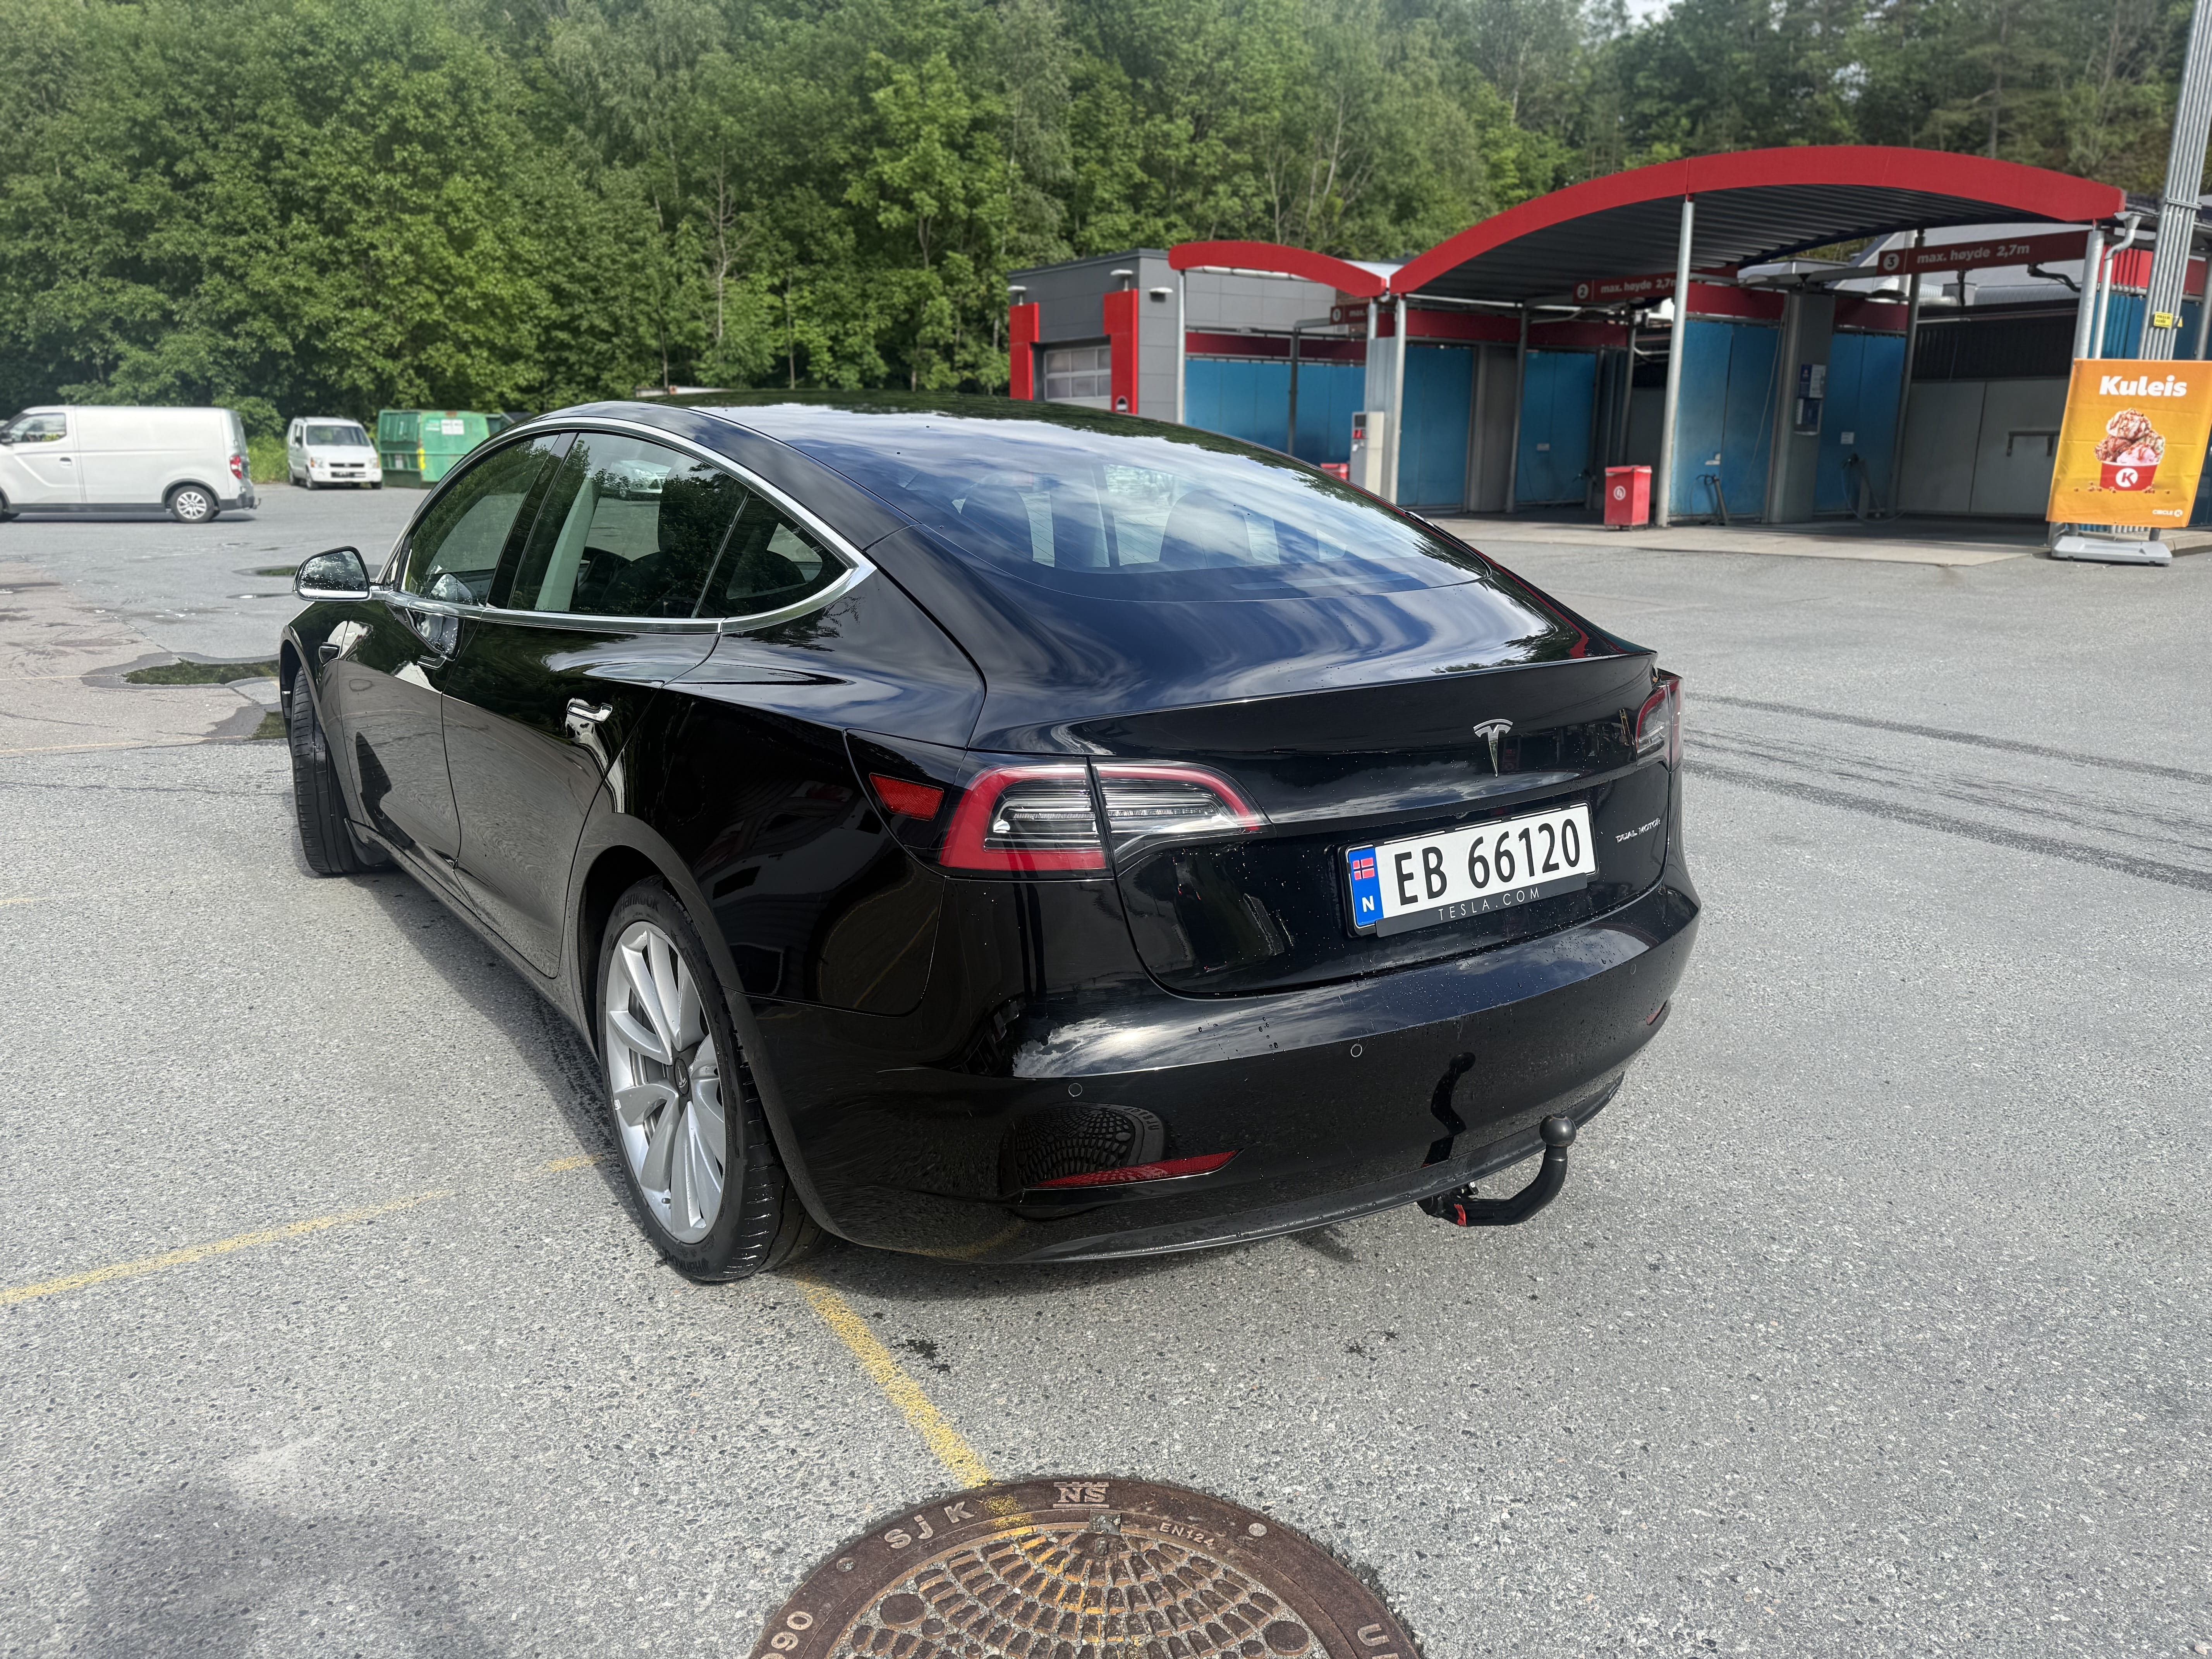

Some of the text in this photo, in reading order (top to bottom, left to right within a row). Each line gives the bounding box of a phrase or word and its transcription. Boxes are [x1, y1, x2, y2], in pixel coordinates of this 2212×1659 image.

[1917, 254, 1947, 264] max.
[1950, 247, 1990, 261] høyde
[1996, 245, 2030, 258] 2,7m
[1601, 285, 1622, 294] max.
[1624, 280, 1652, 293] høyde
[2099, 375, 2187, 397] Kuleis
[1615, 817, 1661, 843] DUAL MOTOR
[1394, 818, 1580, 906] EB 66120
[1362, 896, 1375, 913] N
[1438, 887, 1540, 921] TESLA.COM
[1056, 1486, 1107, 1503] NS
[761, 1611, 813, 1659] 90
